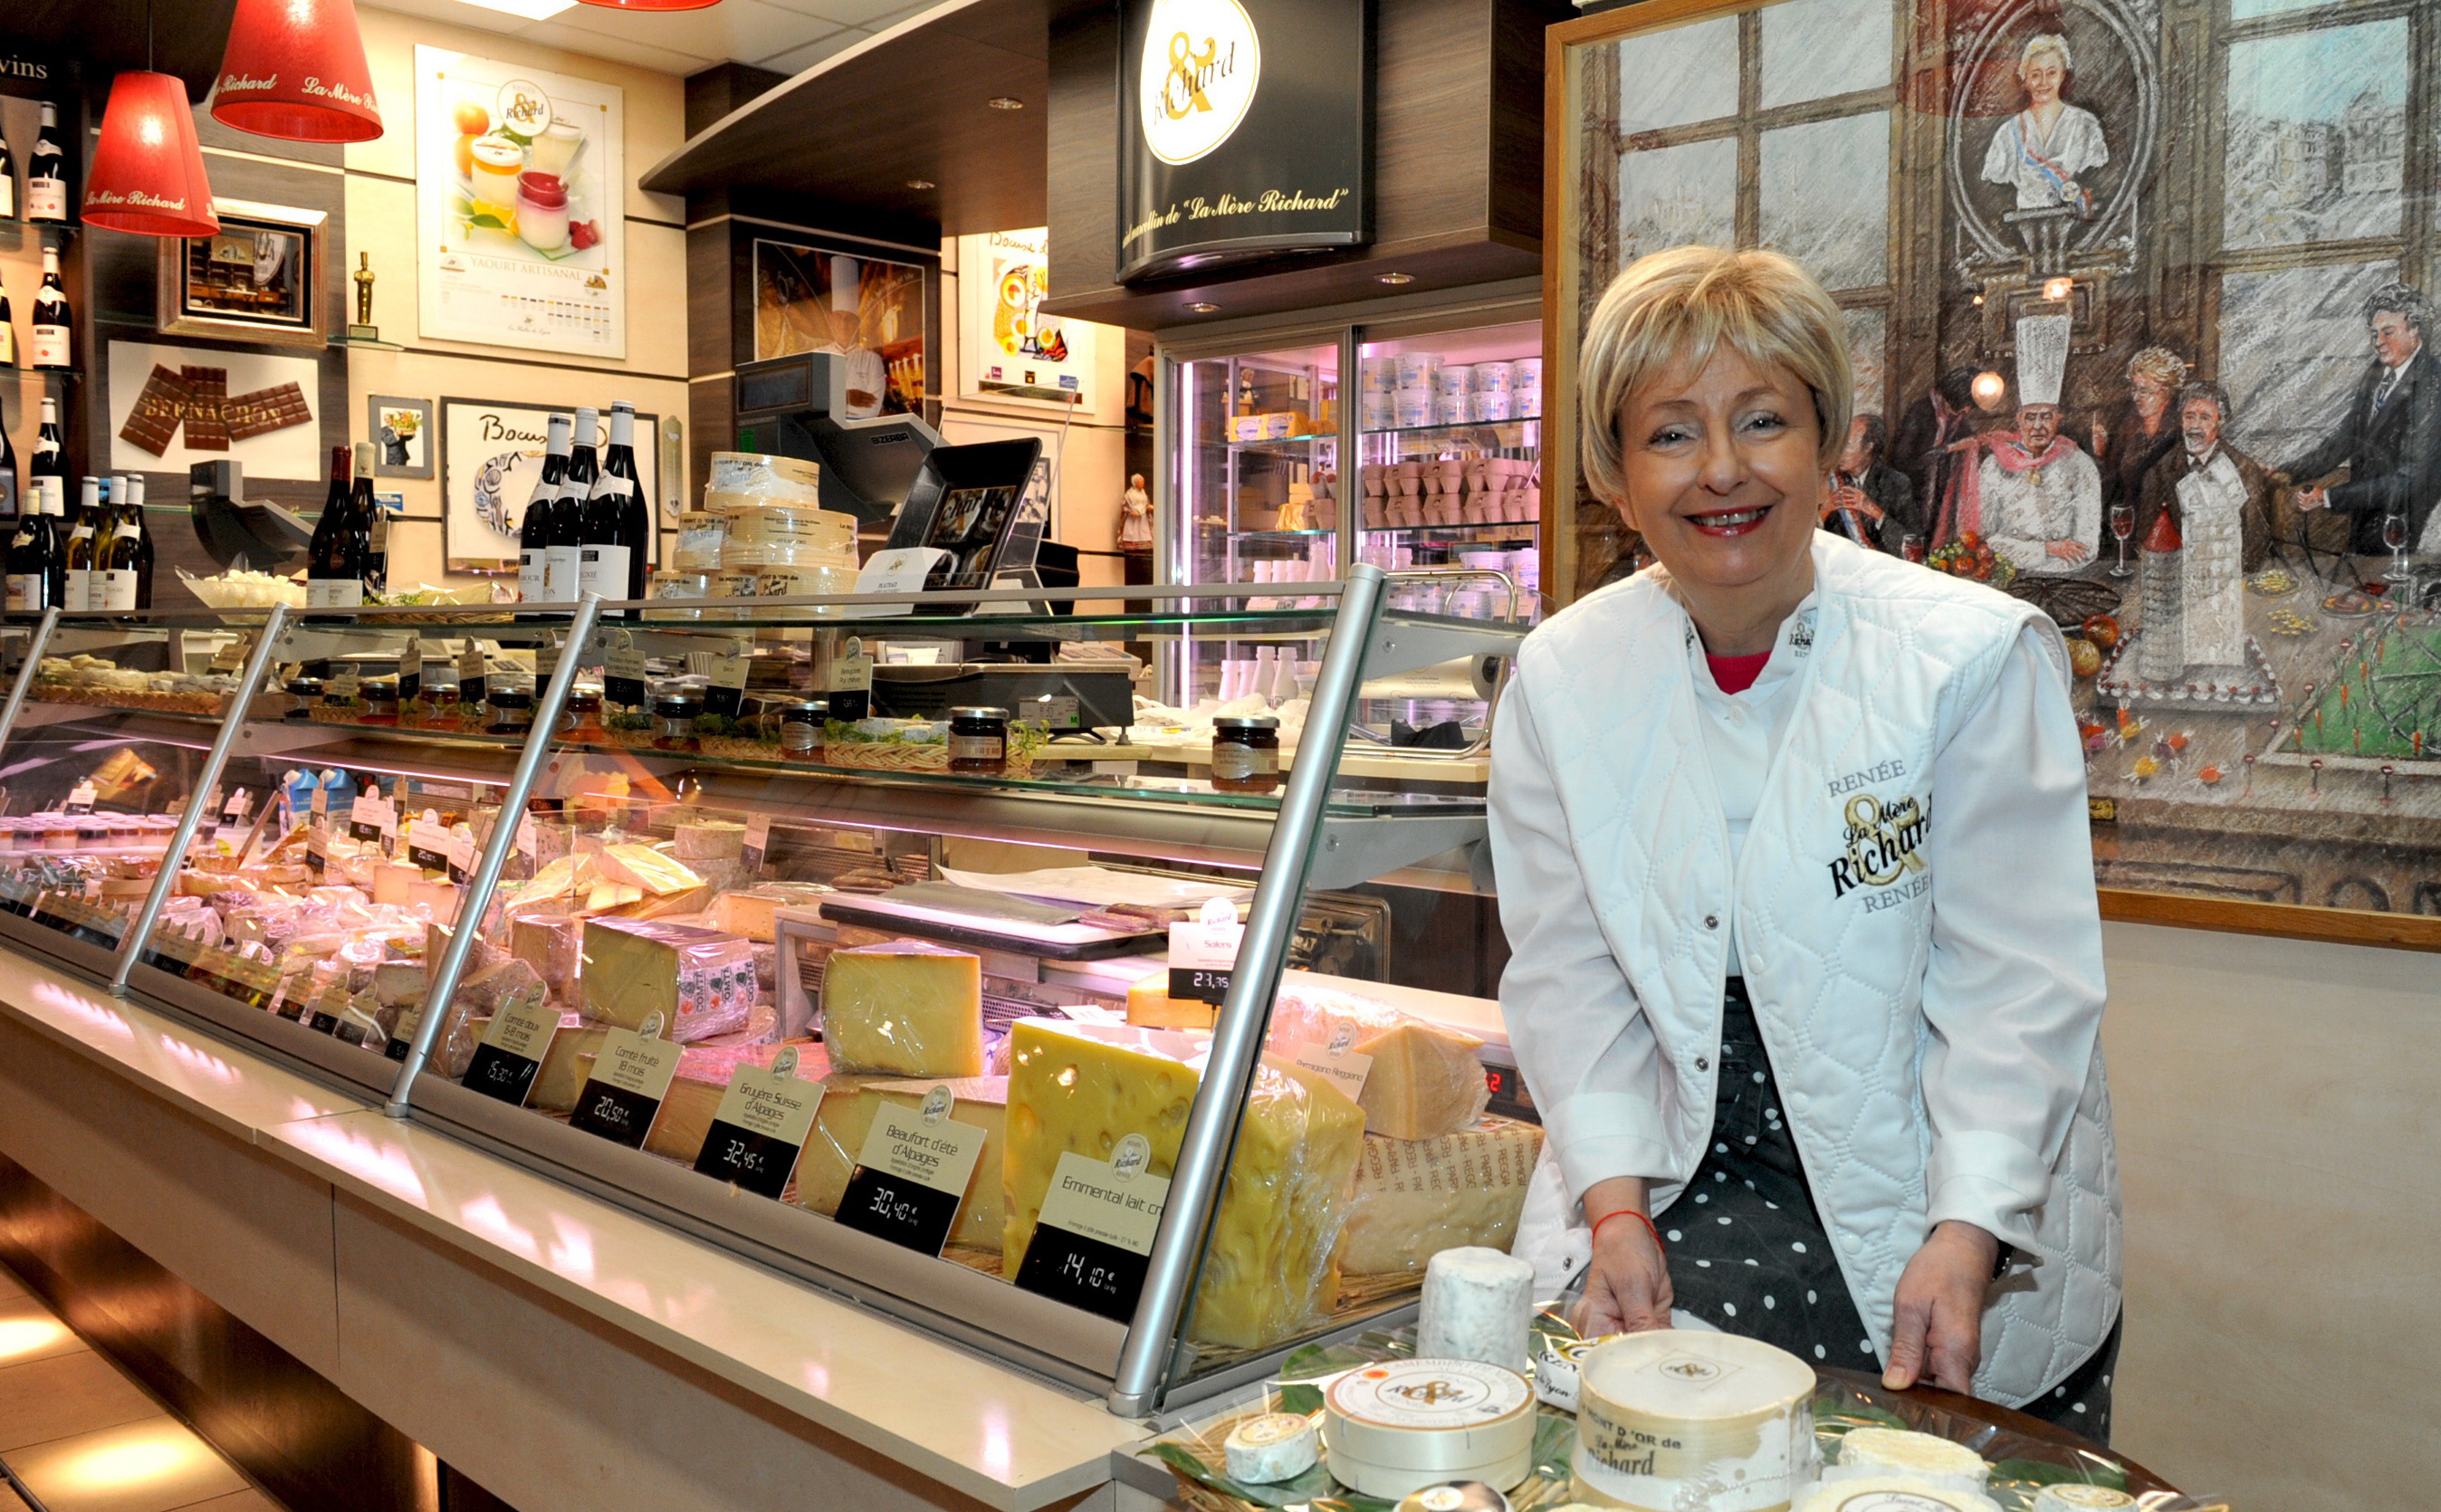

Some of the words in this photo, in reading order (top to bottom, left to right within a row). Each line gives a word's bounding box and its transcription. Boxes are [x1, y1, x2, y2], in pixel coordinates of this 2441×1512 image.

[221, 73, 277, 93] Richard
[302, 76, 328, 96] La
[328, 82, 363, 106] Mère
[506, 103, 544, 119] Richard
[127, 190, 186, 211] Richard
[1211, 193, 1256, 216] Mère
[470, 256, 518, 273] YAOURT
[521, 264, 582, 281] ARTISANAL
[871, 432, 910, 446] BIZERBA
[1827, 759, 1907, 799] RENÉE
[1843, 823, 1870, 849] La
[1875, 795, 1918, 830] Mère
[1826, 790, 1934, 901] Richard
[1862, 874, 1930, 914] RENÉE
[1204, 940, 1232, 949] Salers
[694, 971, 704, 1012] COMTÉ
[721, 966, 732, 1000] OMTÉ
[745, 962, 754, 1003] COMTÉ
[505, 1012, 525, 1028] Comté
[524, 1020, 541, 1032] doux
[516, 1031, 531, 1042] mois
[615, 1045, 639, 1062] Comté
[638, 1052, 660, 1068] fruité
[618, 1059, 627, 1071] 18
[627, 1065, 645, 1077] mois
[1296, 1058, 1331, 1075] Parmigiano
[1332, 1067, 1364, 1082] Reggiano
[594, 1096, 624, 1123] 20,50
[739, 1083, 772, 1102] Gruyère
[773, 1092, 802, 1110] Suisse
[886, 1124, 931, 1148] Beaufort
[931, 1139, 958, 1157] d'été
[723, 1139, 758, 1170] 32,45
[892, 1144, 940, 1168] d'Alpages
[1114, 1155, 1143, 1169] Richard
[869, 1187, 910, 1221] 30,40
[1061, 1175, 1125, 1205] Emmental
[1125, 1192, 1144, 1212] lait
[1147, 1202, 1163, 1216] cr
[1063, 1252, 1105, 1288] 14,10
[1661, 1438, 1681, 1450] de
